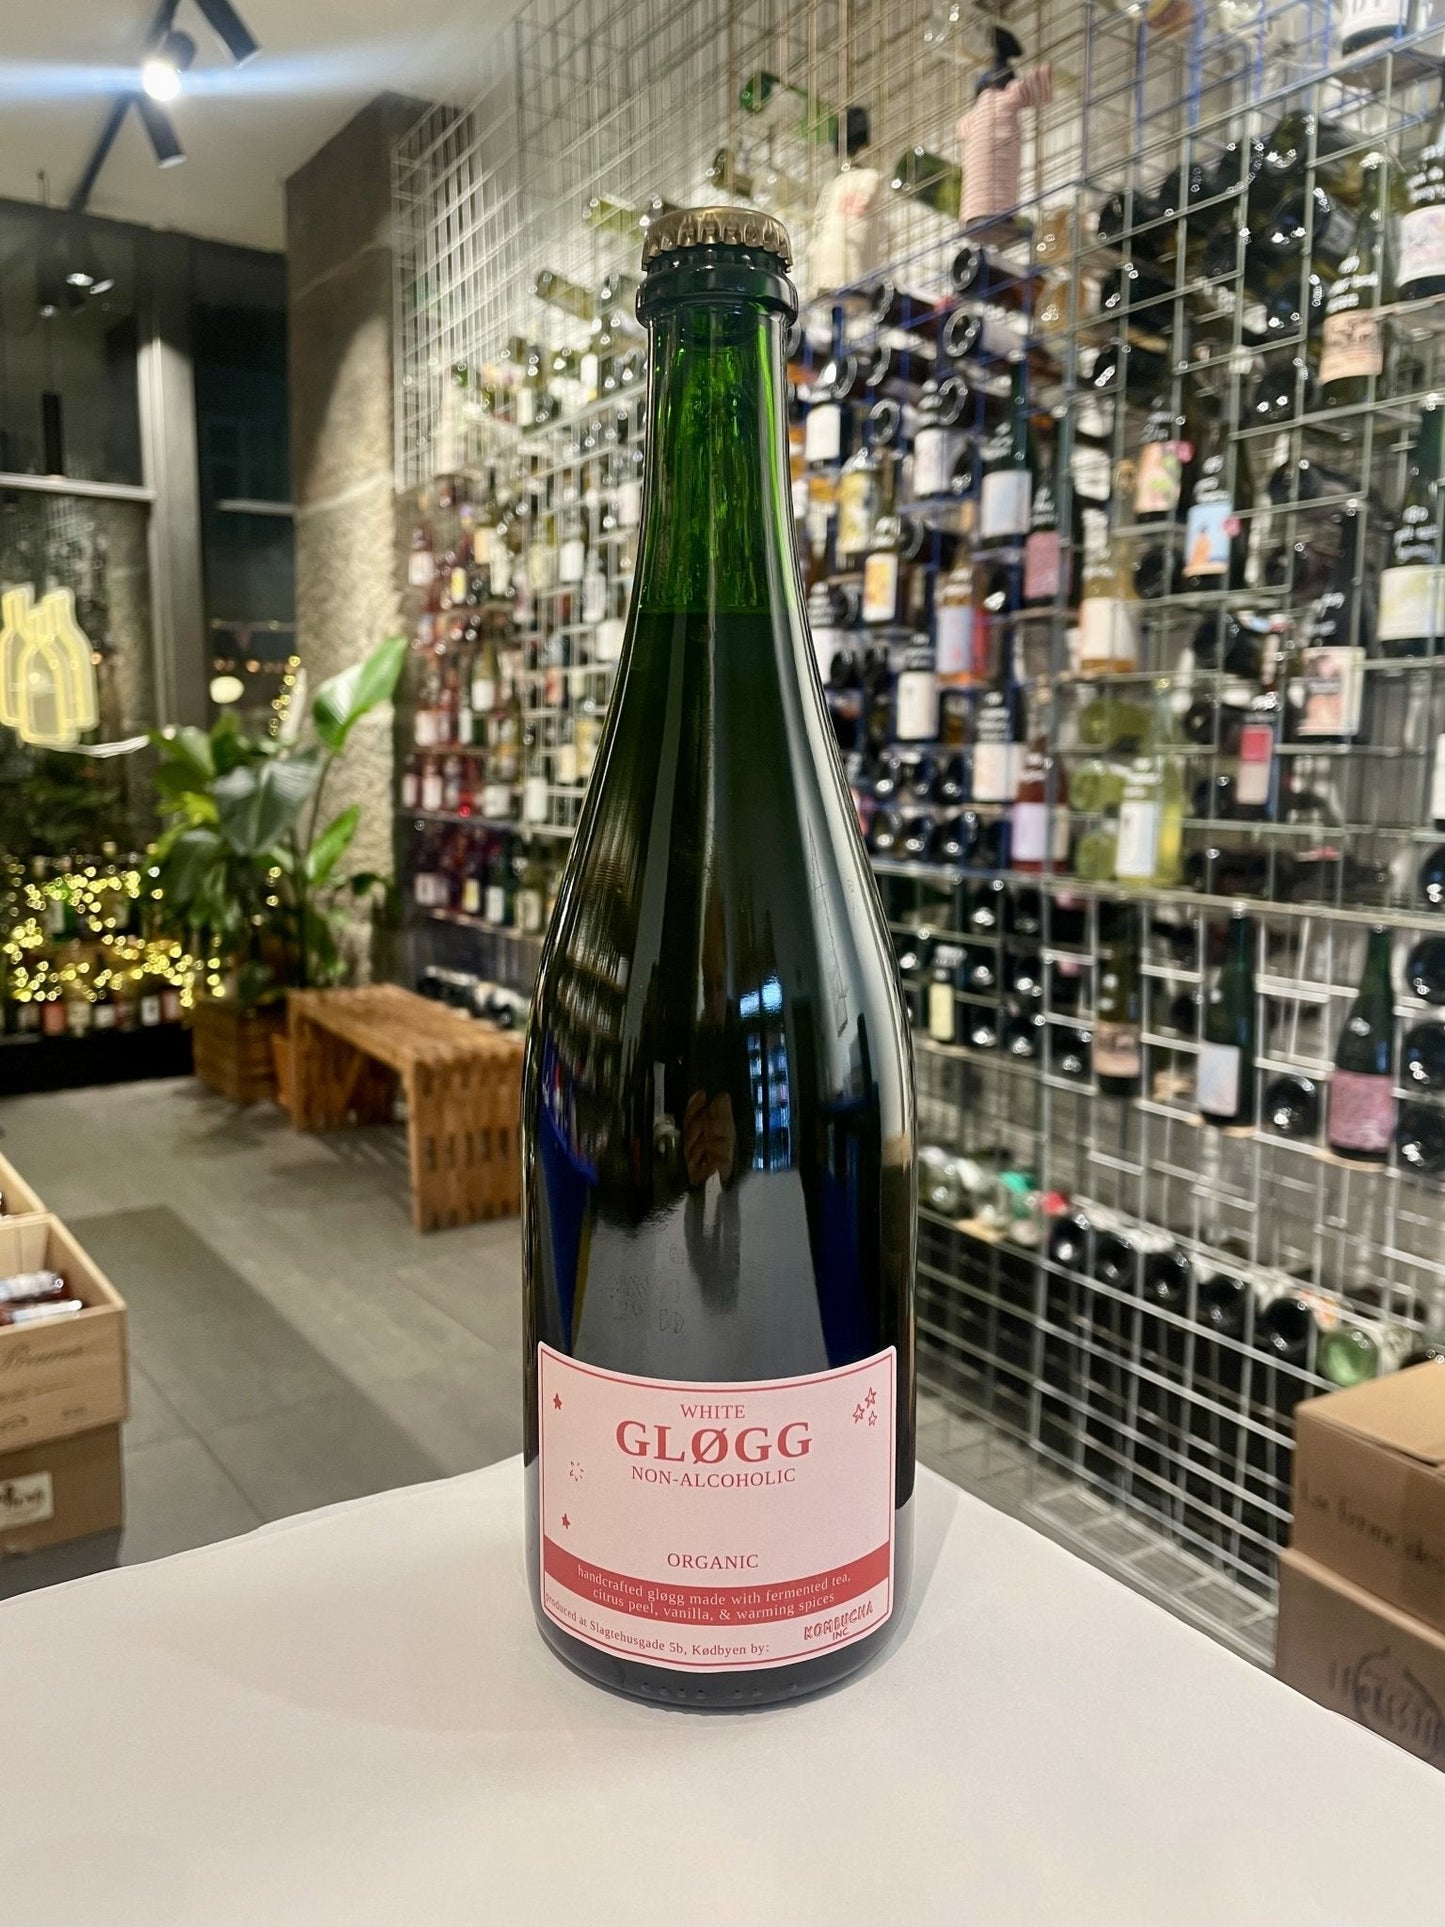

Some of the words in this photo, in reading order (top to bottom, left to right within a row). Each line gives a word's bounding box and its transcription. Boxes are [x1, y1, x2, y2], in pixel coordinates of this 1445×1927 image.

[680, 1403, 745, 1419] WHITE
[616, 1420, 813, 1464] GLØGG
[631, 1465, 796, 1488] NON-ALCOHOLIC
[667, 1553, 759, 1570] ORGANIC
[577, 1564, 643, 1597] handcrafted
[647, 1589, 685, 1606] gløgg
[689, 1593, 725, 1605] made
[731, 1592, 761, 1605] with
[766, 1578, 828, 1602] fermented
[832, 1573, 851, 1587] tea,
[593, 1588, 624, 1607] citrus
[628, 1600, 659, 1616] peel,
[663, 1607, 714, 1621] vanilla,
[719, 1608, 731, 1620] &
[736, 1603, 795, 1620] warming
[799, 1592, 835, 1612] spices
[803, 1599, 874, 1641] KOMBUCHA
[578, 1616, 588, 1627] at
[590, 1620, 665, 1650] Slagtehusgade
[669, 1642, 687, 1656] 5b,
[692, 1644, 746, 1658] Kødbyen
[751, 1643, 770, 1657] by:
